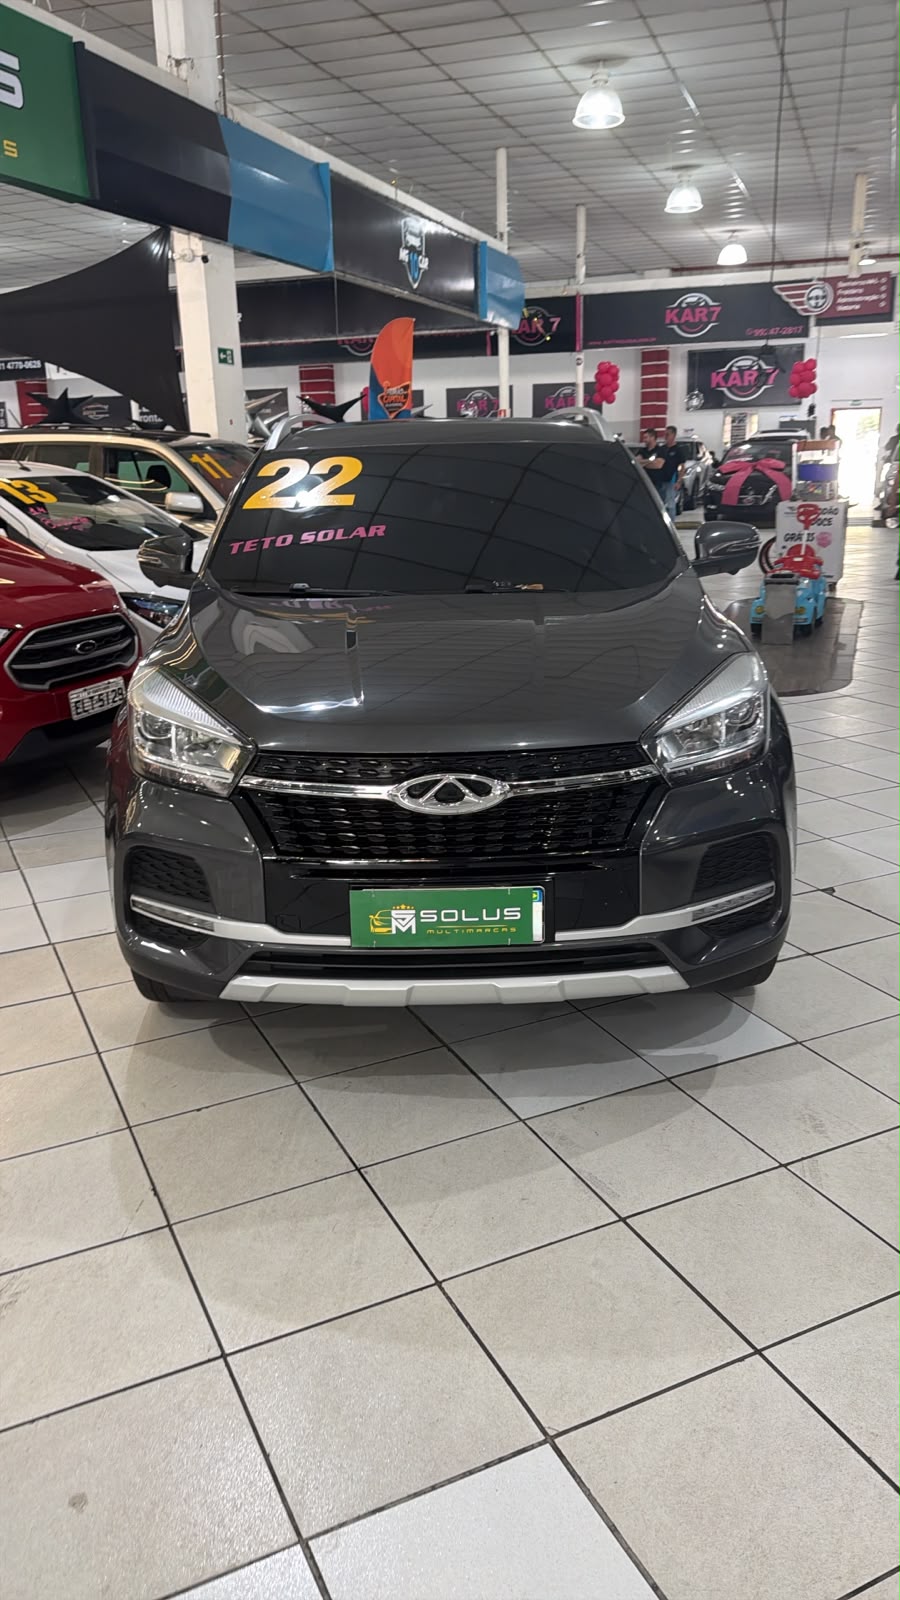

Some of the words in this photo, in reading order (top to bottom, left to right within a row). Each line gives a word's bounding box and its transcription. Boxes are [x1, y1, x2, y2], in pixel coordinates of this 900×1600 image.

[511, 318, 546, 335] AR
[189, 453, 233, 479] 11
[0, 480, 58, 505] 13
[242, 456, 363, 510] 22
[229, 534, 295, 555] TETO
[299, 525, 387, 544] SOLAR
[420, 907, 521, 923] SOLUS
[426, 927, 518, 935] MULTIMARCAS
